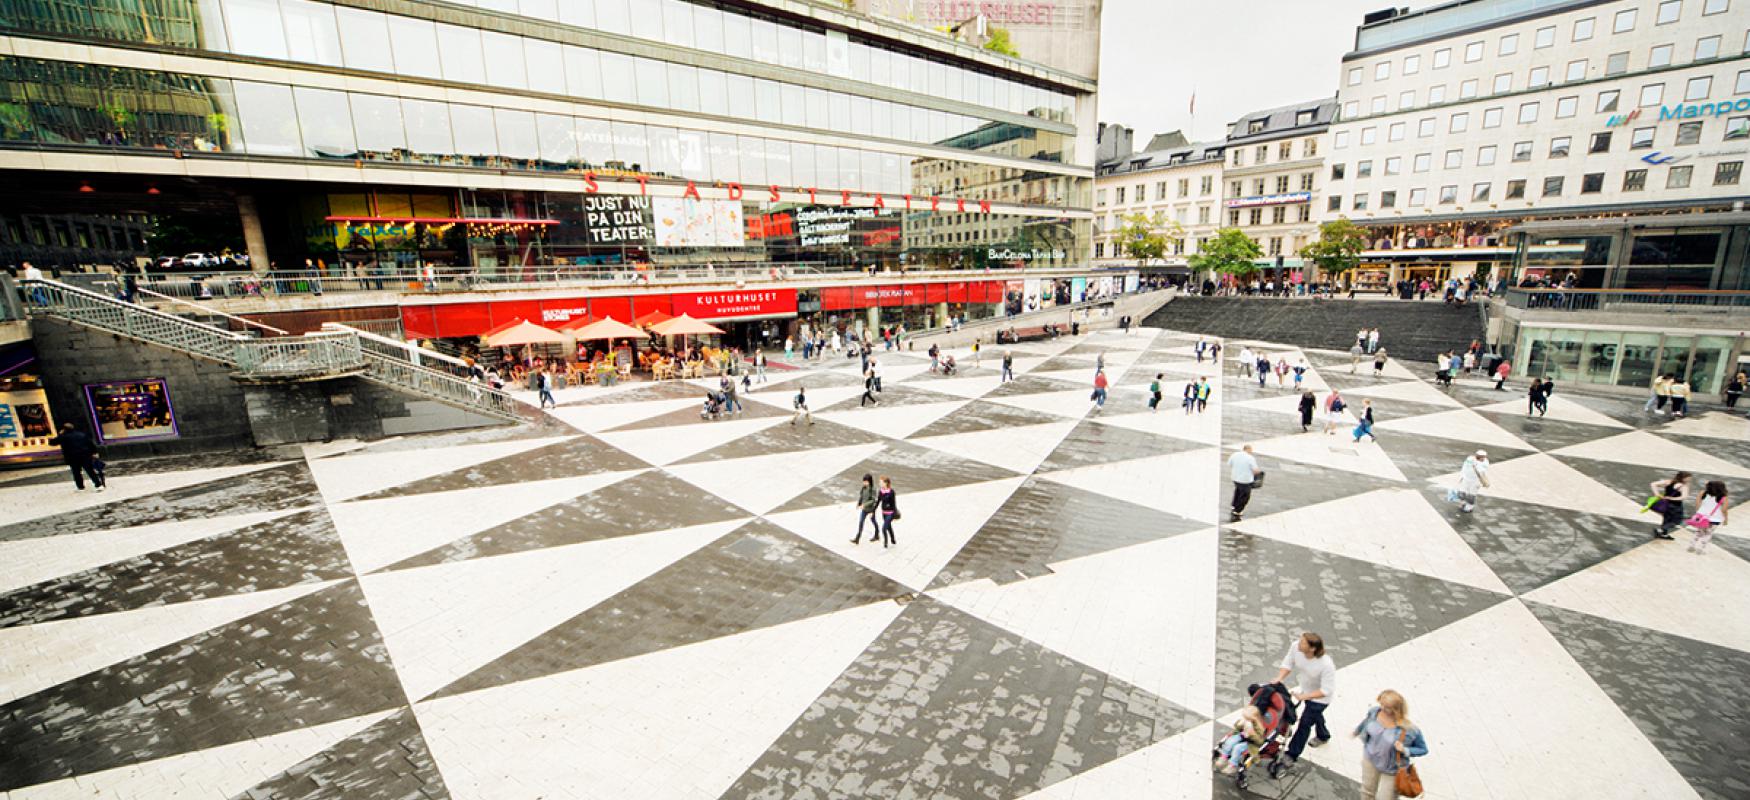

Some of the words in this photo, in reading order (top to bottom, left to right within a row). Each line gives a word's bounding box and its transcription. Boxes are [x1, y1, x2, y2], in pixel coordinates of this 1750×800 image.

[585, 196, 624, 211] JUST
[629, 196, 649, 209] NU
[614, 210, 643, 225] DIN
[590, 225, 653, 242] TEATER:
[696, 292, 777, 305] KULTURHUSET
